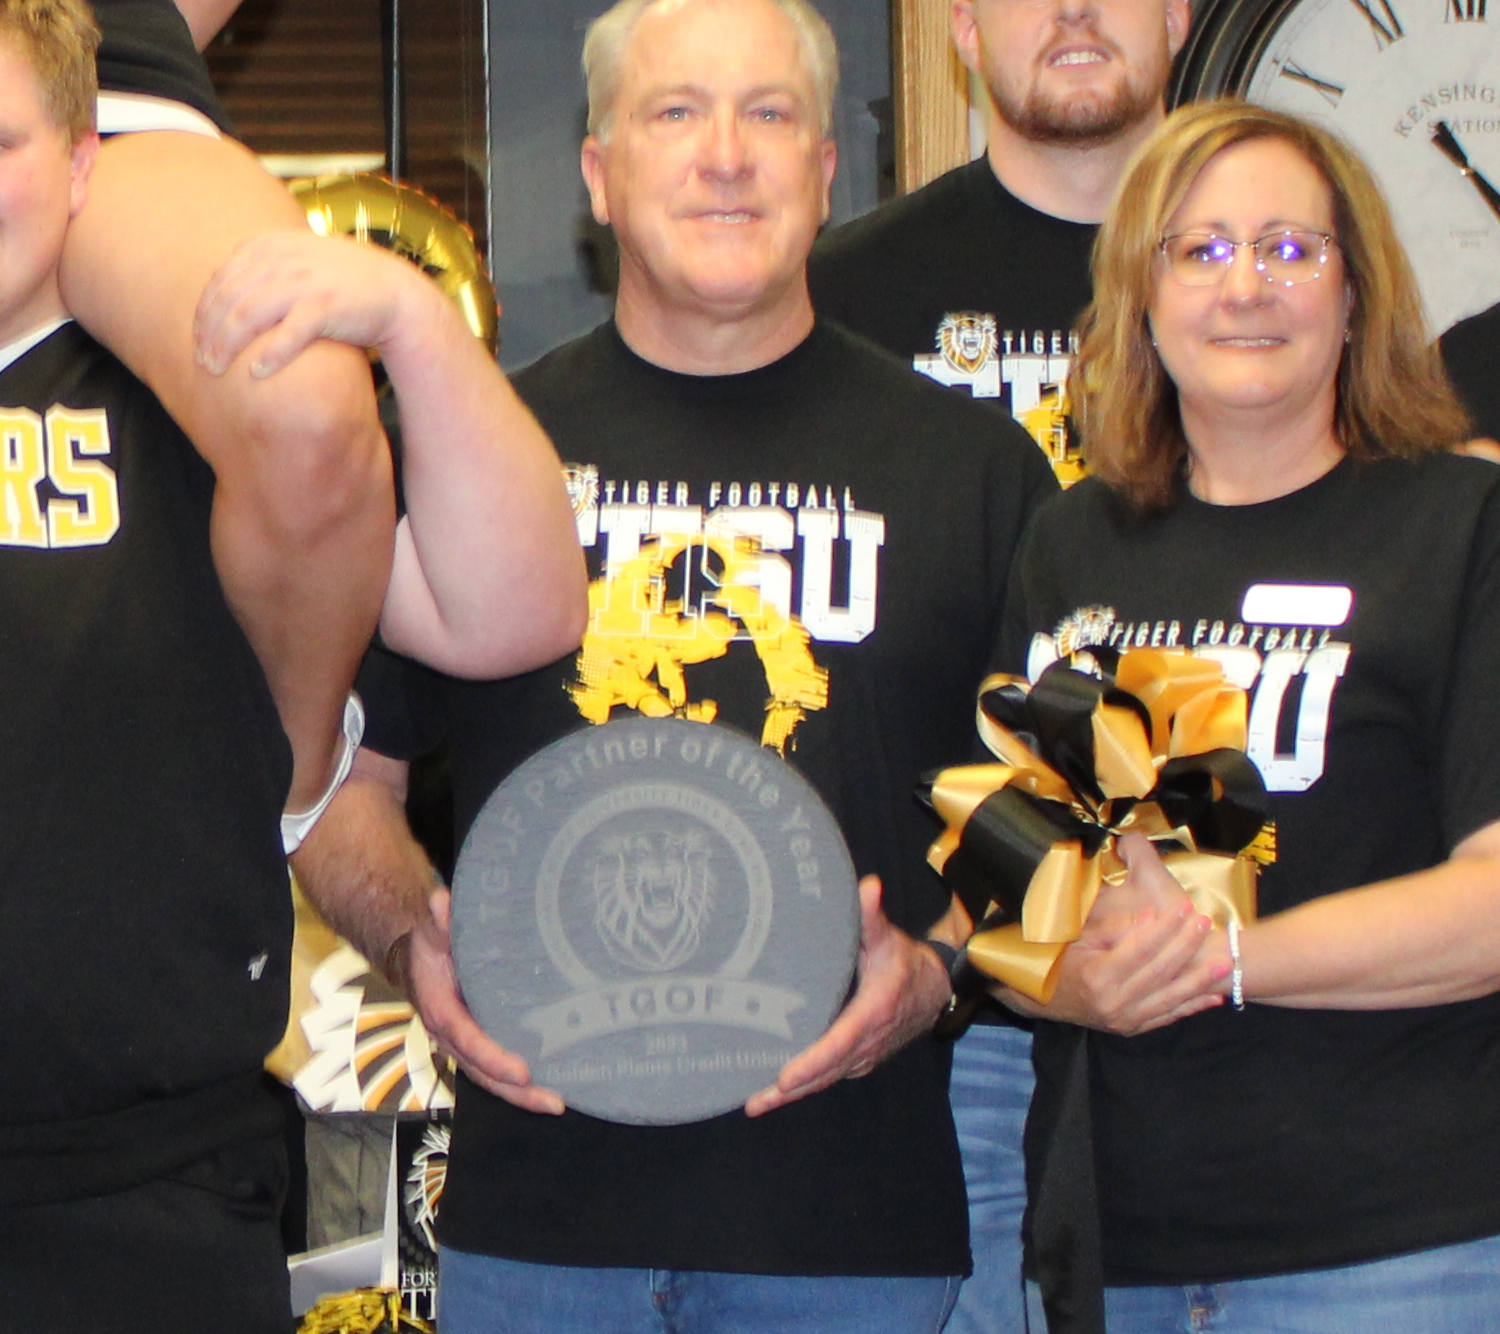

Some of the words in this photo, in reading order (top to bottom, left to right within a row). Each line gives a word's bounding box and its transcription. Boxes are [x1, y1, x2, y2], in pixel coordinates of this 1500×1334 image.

[1002, 329, 1079, 356] TIGER
[603, 480, 689, 508] TIGER
[709, 481, 855, 512] FOOTBALL
[1109, 619, 1182, 648] TIGER
[1192, 618, 1331, 651] FOOTBALL
[479, 805, 527, 925] TGOF
[524, 732, 665, 809] Partner
[679, 735, 725, 766] of
[724, 751, 781, 807] the
[780, 802, 823, 901] Year
[600, 984, 726, 1020] TGOF
